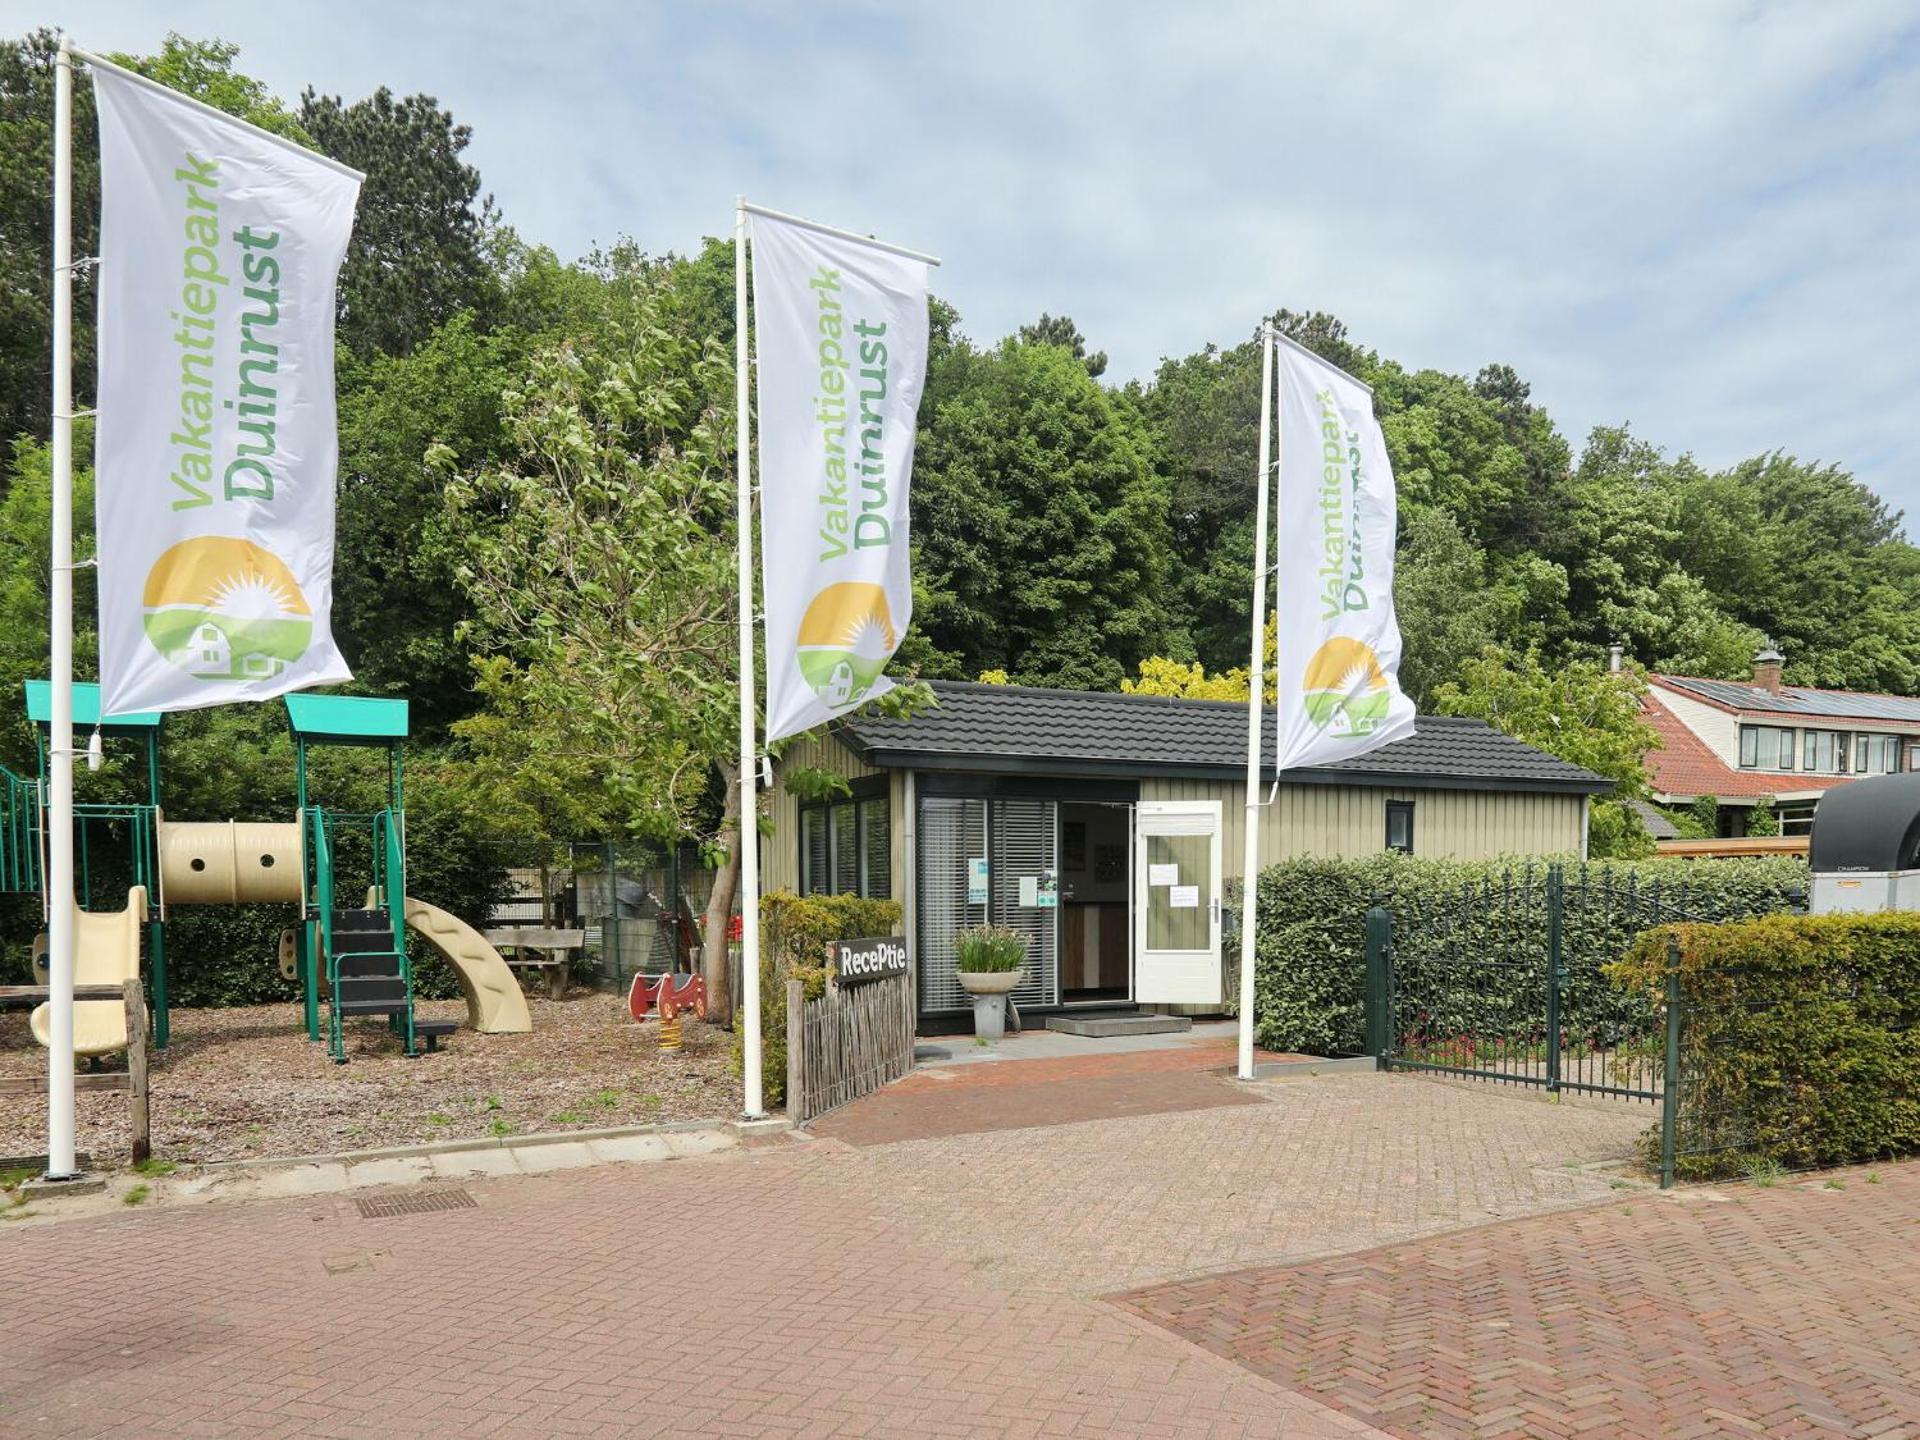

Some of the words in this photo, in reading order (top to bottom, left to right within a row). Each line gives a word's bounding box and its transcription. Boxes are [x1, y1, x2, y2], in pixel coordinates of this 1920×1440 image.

[170, 152, 229, 511] Vakantiepark
[223, 225, 279, 501] Duinrust
[809, 265, 850, 562] Vakantiepark
[853, 318, 891, 549] Duinrust
[1315, 388, 1347, 622] Vakantiepark
